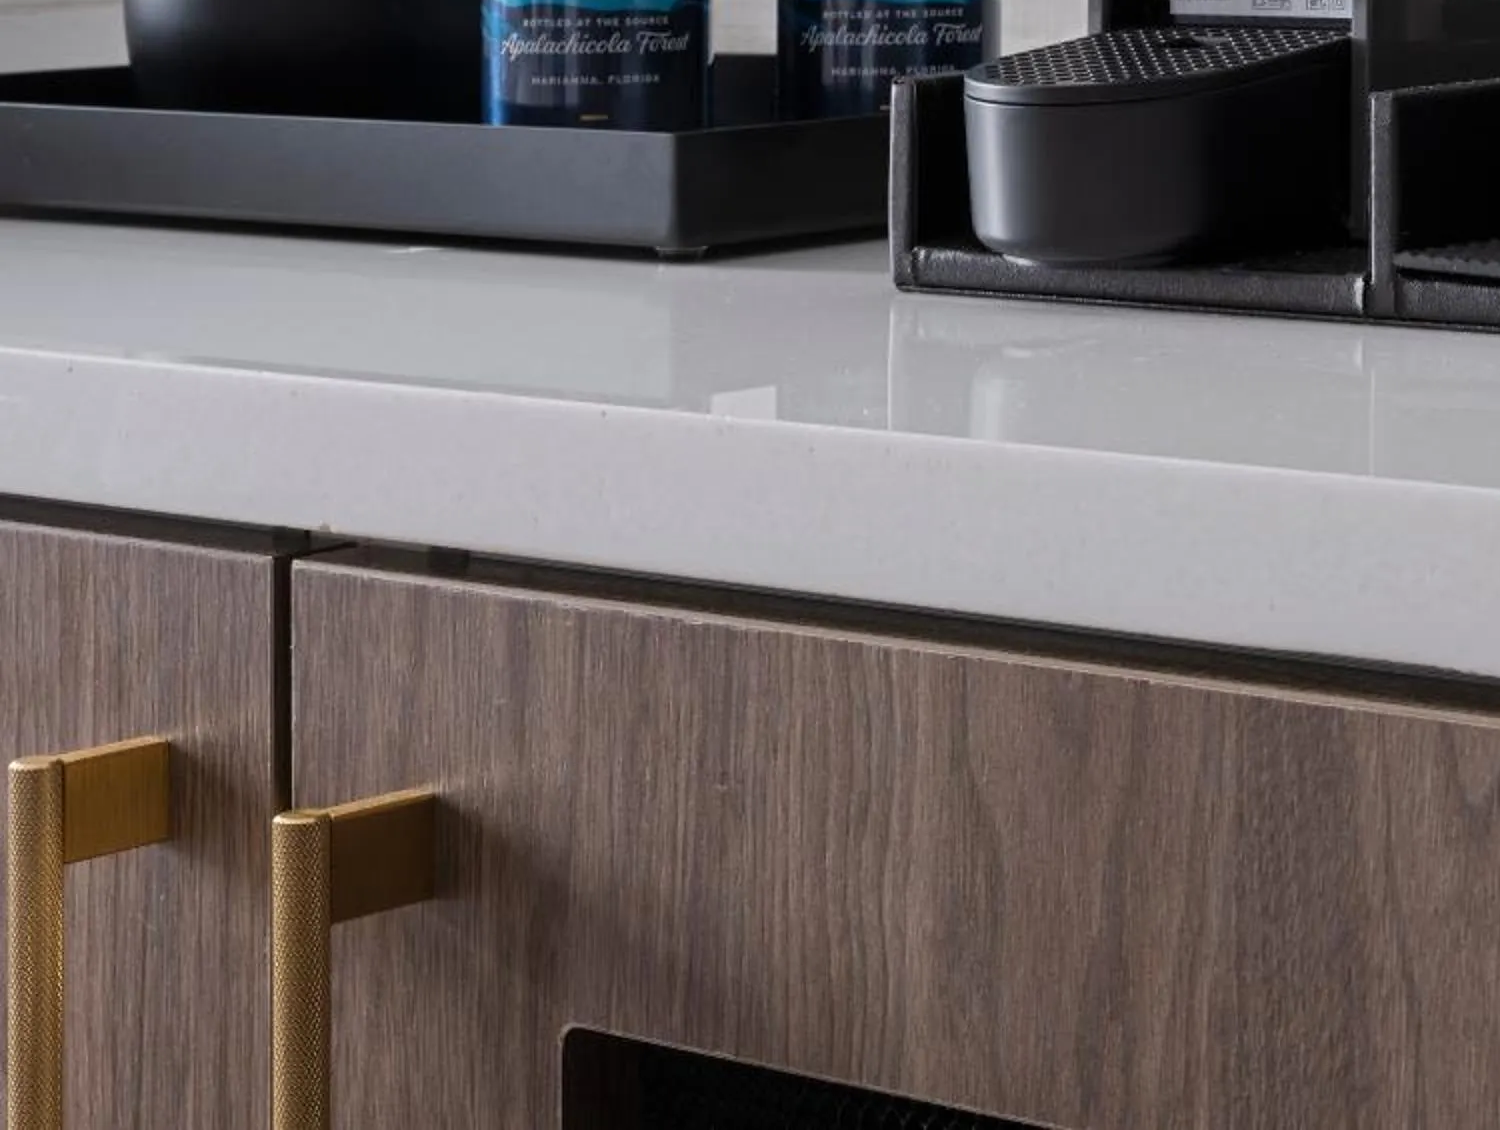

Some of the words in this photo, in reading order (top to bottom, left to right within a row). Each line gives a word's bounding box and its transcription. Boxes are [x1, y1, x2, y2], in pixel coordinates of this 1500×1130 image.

[500, 31, 632, 63] Apalachicola
[636, 30, 690, 55] Forest
[800, 23, 928, 54] Apalachicola
[933, 21, 983, 46] Forest
